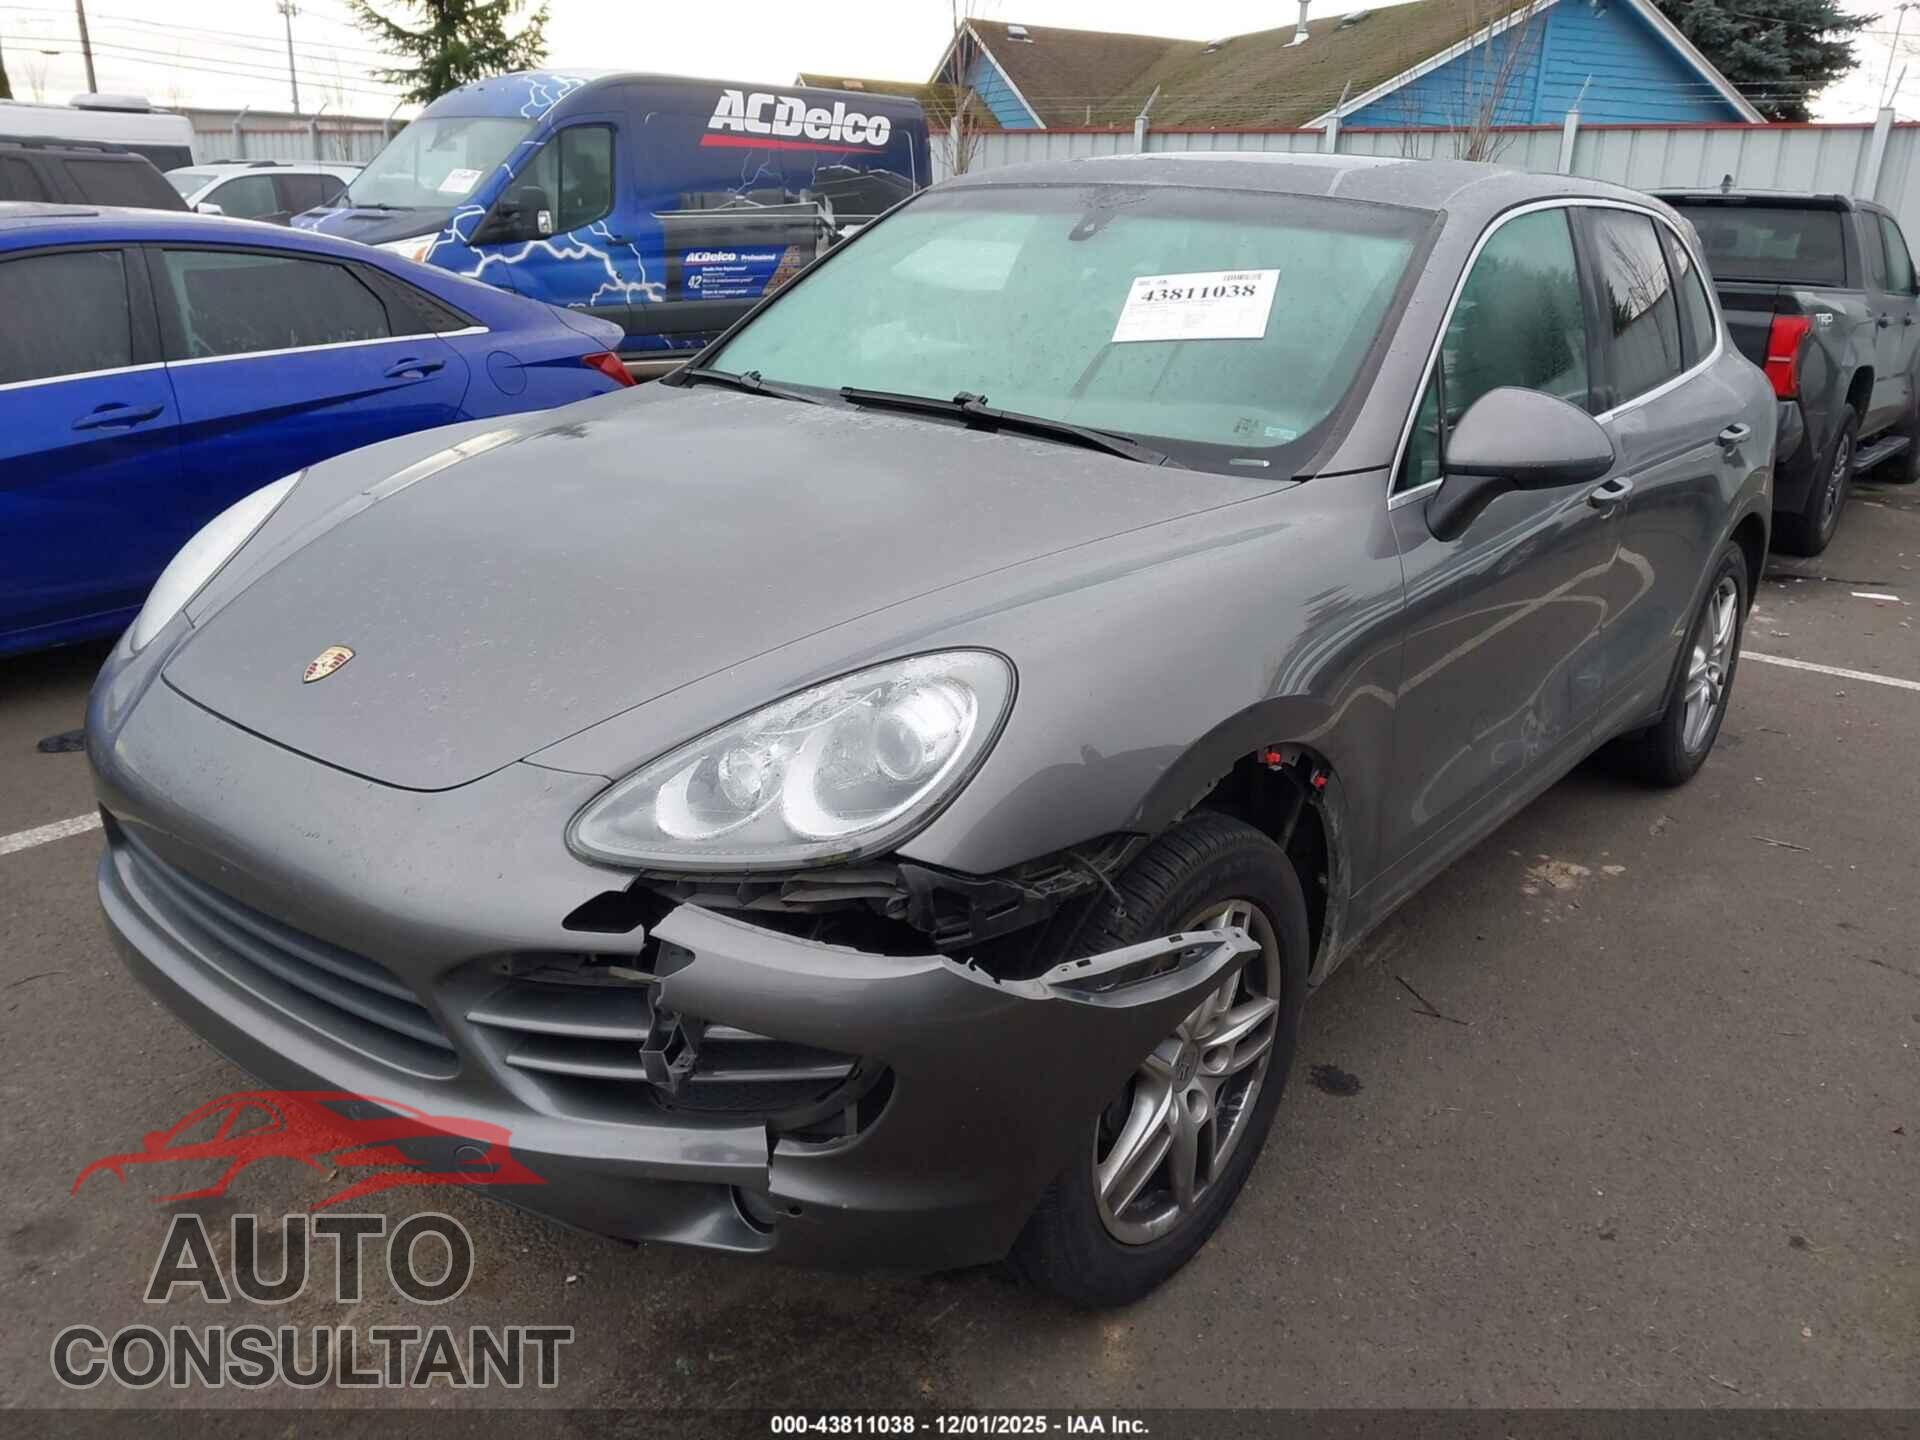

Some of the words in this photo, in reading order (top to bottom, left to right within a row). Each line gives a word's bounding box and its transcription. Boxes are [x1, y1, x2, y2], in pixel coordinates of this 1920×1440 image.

[708, 89, 891, 146] ACDelco
[686, 251, 737, 262] ACDelco
[687, 275, 702, 289] 42
[1141, 285, 1256, 302] 43811038
